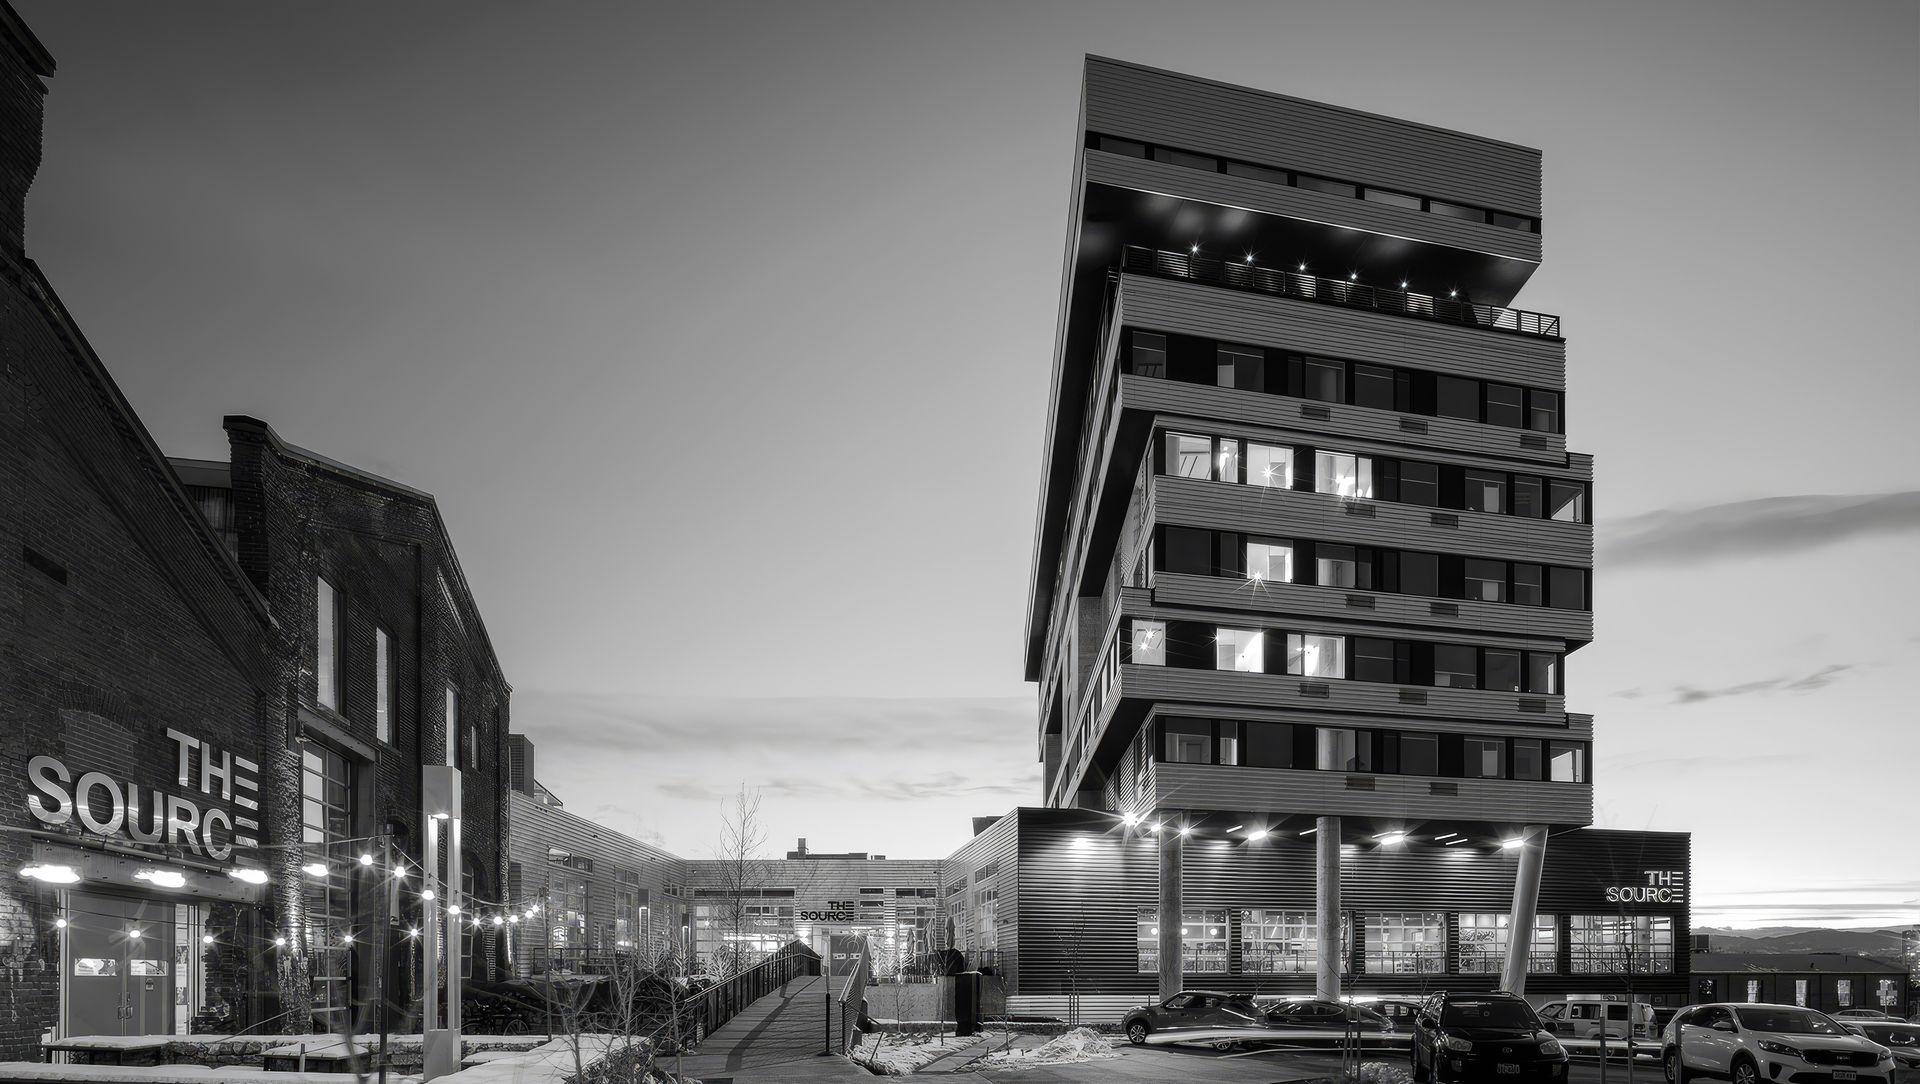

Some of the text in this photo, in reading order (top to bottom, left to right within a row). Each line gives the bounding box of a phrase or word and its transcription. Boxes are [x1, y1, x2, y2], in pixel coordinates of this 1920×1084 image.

[167, 728, 258, 810] THE
[28, 755, 258, 865] SOURCE
[1644, 870, 1684, 886] THE
[1606, 886, 1684, 903] SOURCE
[828, 901, 854, 910] THE
[800, 911, 854, 921] SOURCE
